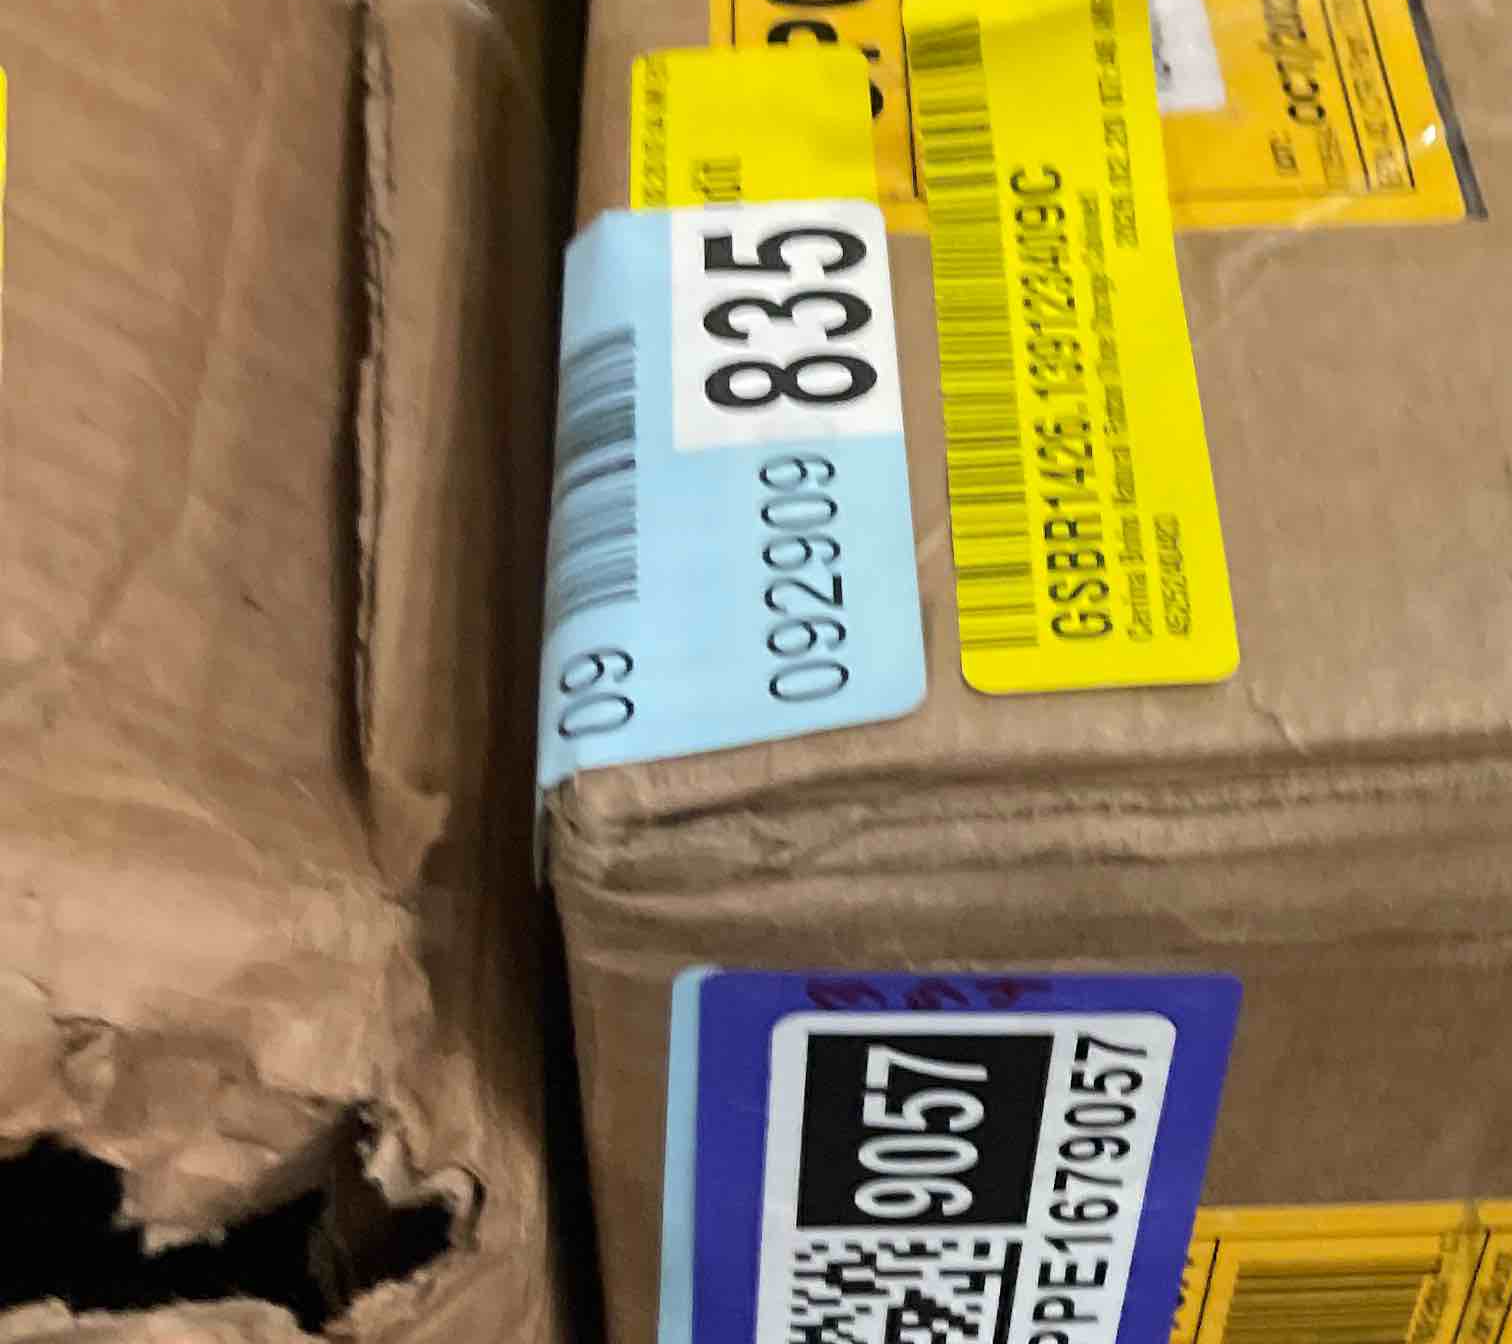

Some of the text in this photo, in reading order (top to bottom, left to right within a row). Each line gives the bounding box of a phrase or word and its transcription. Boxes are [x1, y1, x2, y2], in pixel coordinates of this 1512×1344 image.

[702, 228, 879, 409] 835
[757, 452, 850, 703] 092909
[557, 646, 635, 741] 09
[853, 1042, 989, 1219] 9057
